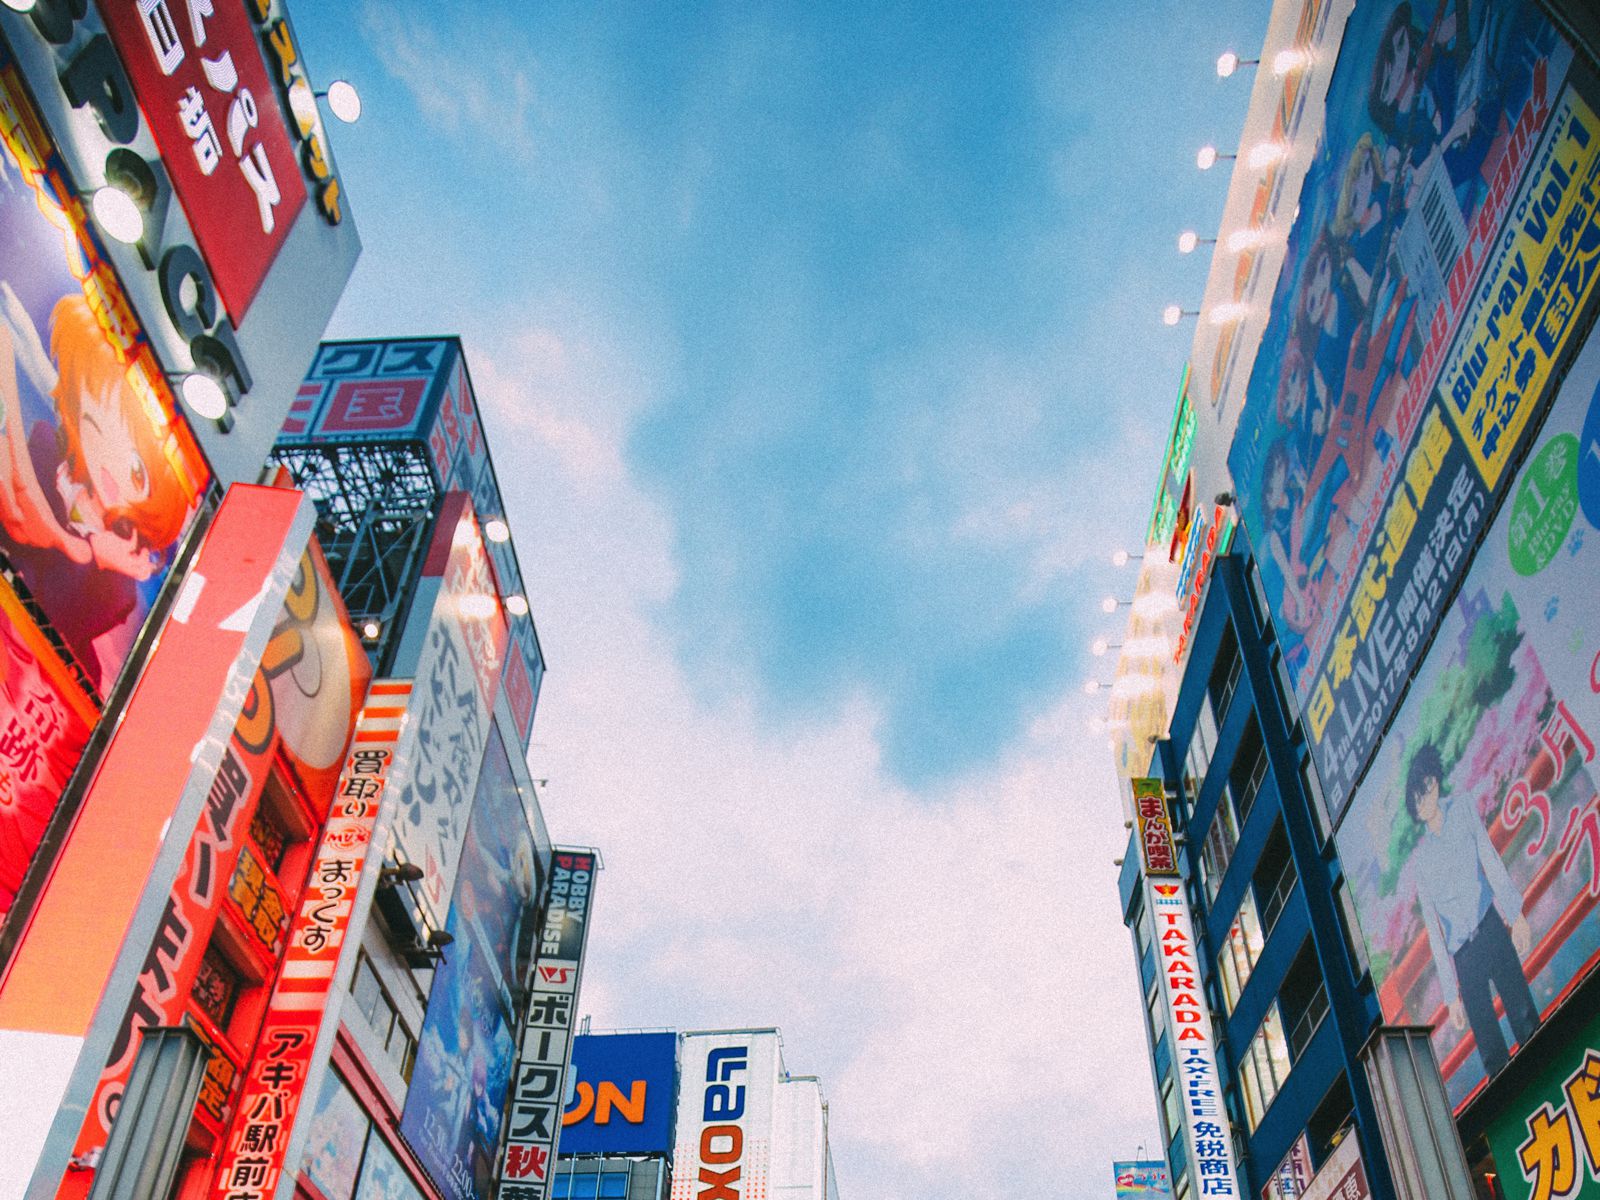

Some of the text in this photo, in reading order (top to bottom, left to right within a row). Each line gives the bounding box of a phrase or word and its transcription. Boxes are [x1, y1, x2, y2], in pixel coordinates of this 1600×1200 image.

[1450, 244, 1531, 420] Blu-ray
[1305, 400, 1454, 748] 日本武道館
[1138, 797, 1175, 871] まんが喫茶
[303, 859, 353, 952] まっくす
[541, 855, 574, 956] PARADISE
[571, 855, 592, 923] HOBBY
[1158, 912, 1206, 1041] TAKARADA
[1193, 1121, 1233, 1196] 免税商店
